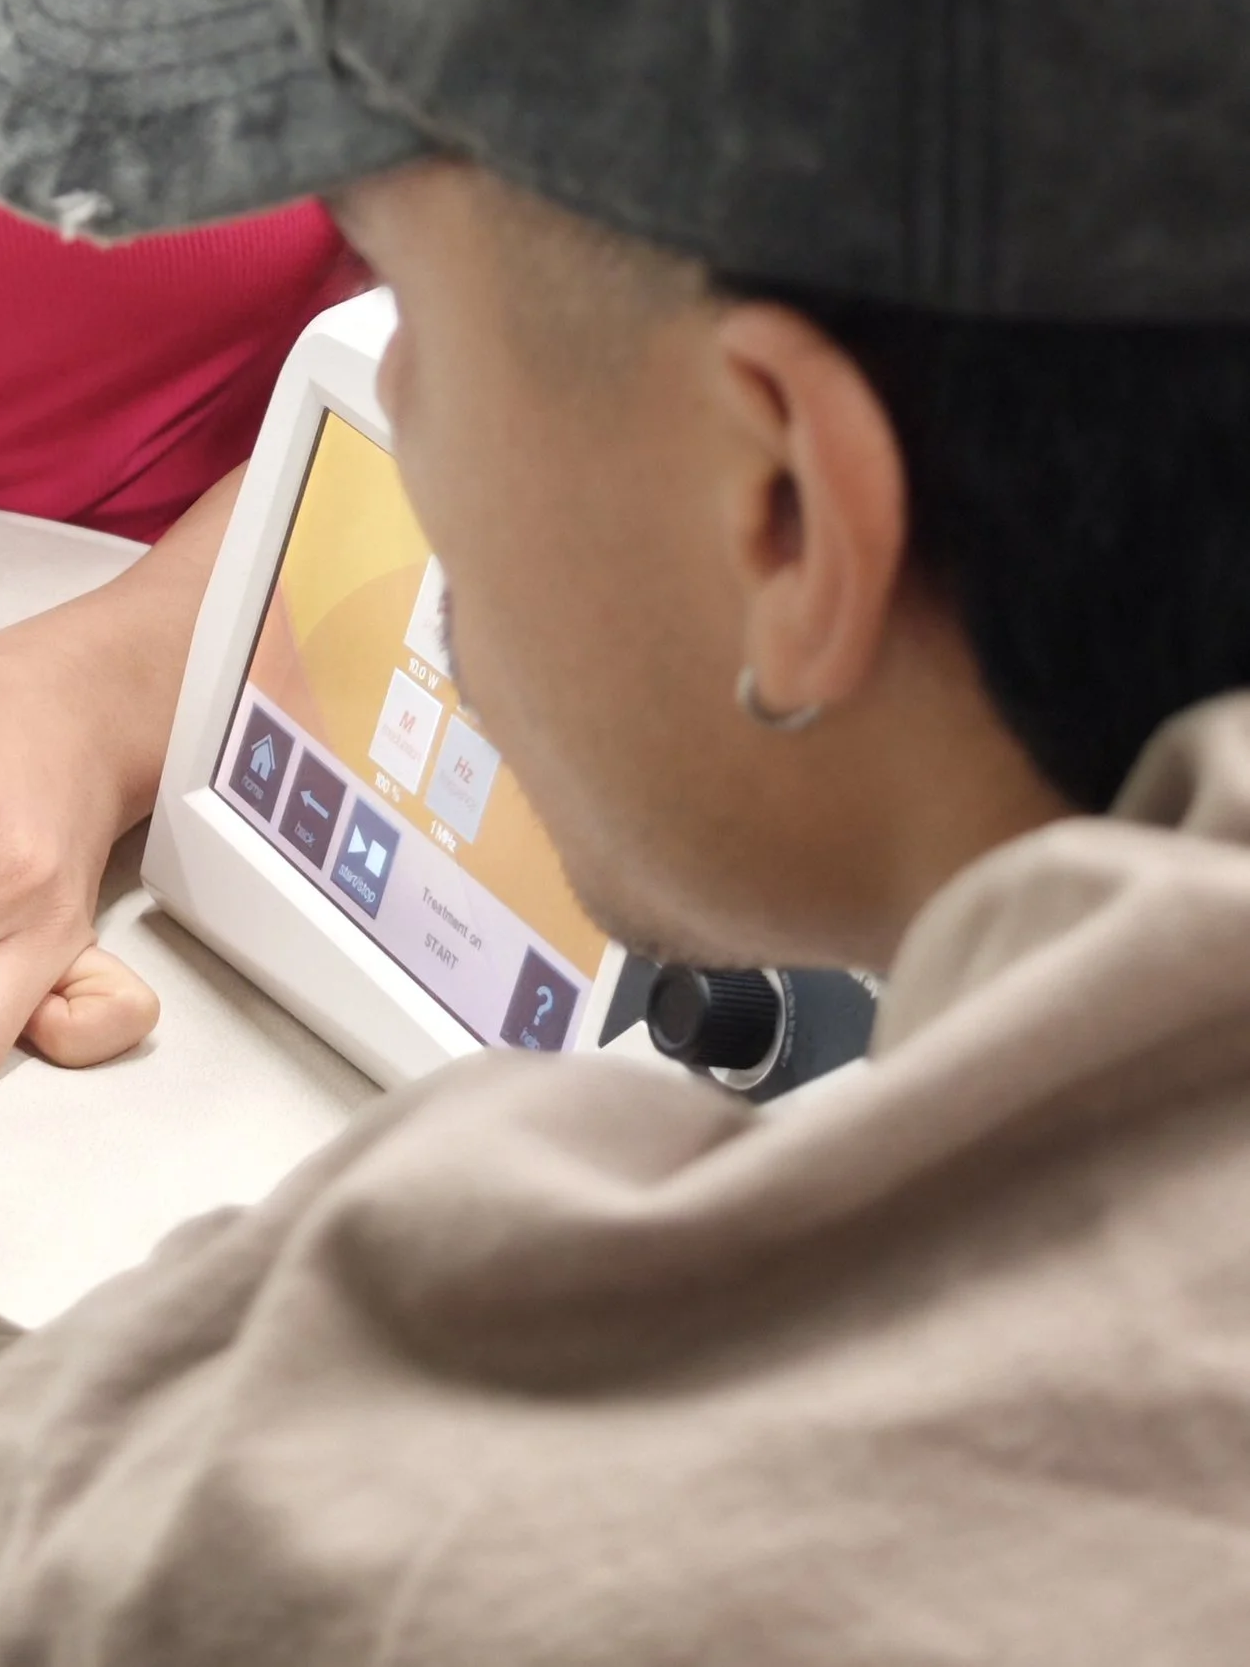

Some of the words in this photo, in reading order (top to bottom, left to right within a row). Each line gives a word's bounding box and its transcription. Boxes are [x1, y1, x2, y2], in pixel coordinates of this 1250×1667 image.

[409, 658, 426, 680] 10.0
[428, 670, 439, 689] W
[399, 710, 416, 733] M
[454, 756, 474, 784] Hz
[242, 773, 265, 800] home
[375, 771, 390, 793] 100
[392, 785, 400, 803] %
[294, 820, 316, 848] back
[430, 819, 437, 835] 1
[436, 823, 457, 853] MHz
[338, 864, 376, 903] start/stop
[421, 886, 469, 939] Treatment
[469, 933, 482, 951] on
[424, 933, 459, 970] START
